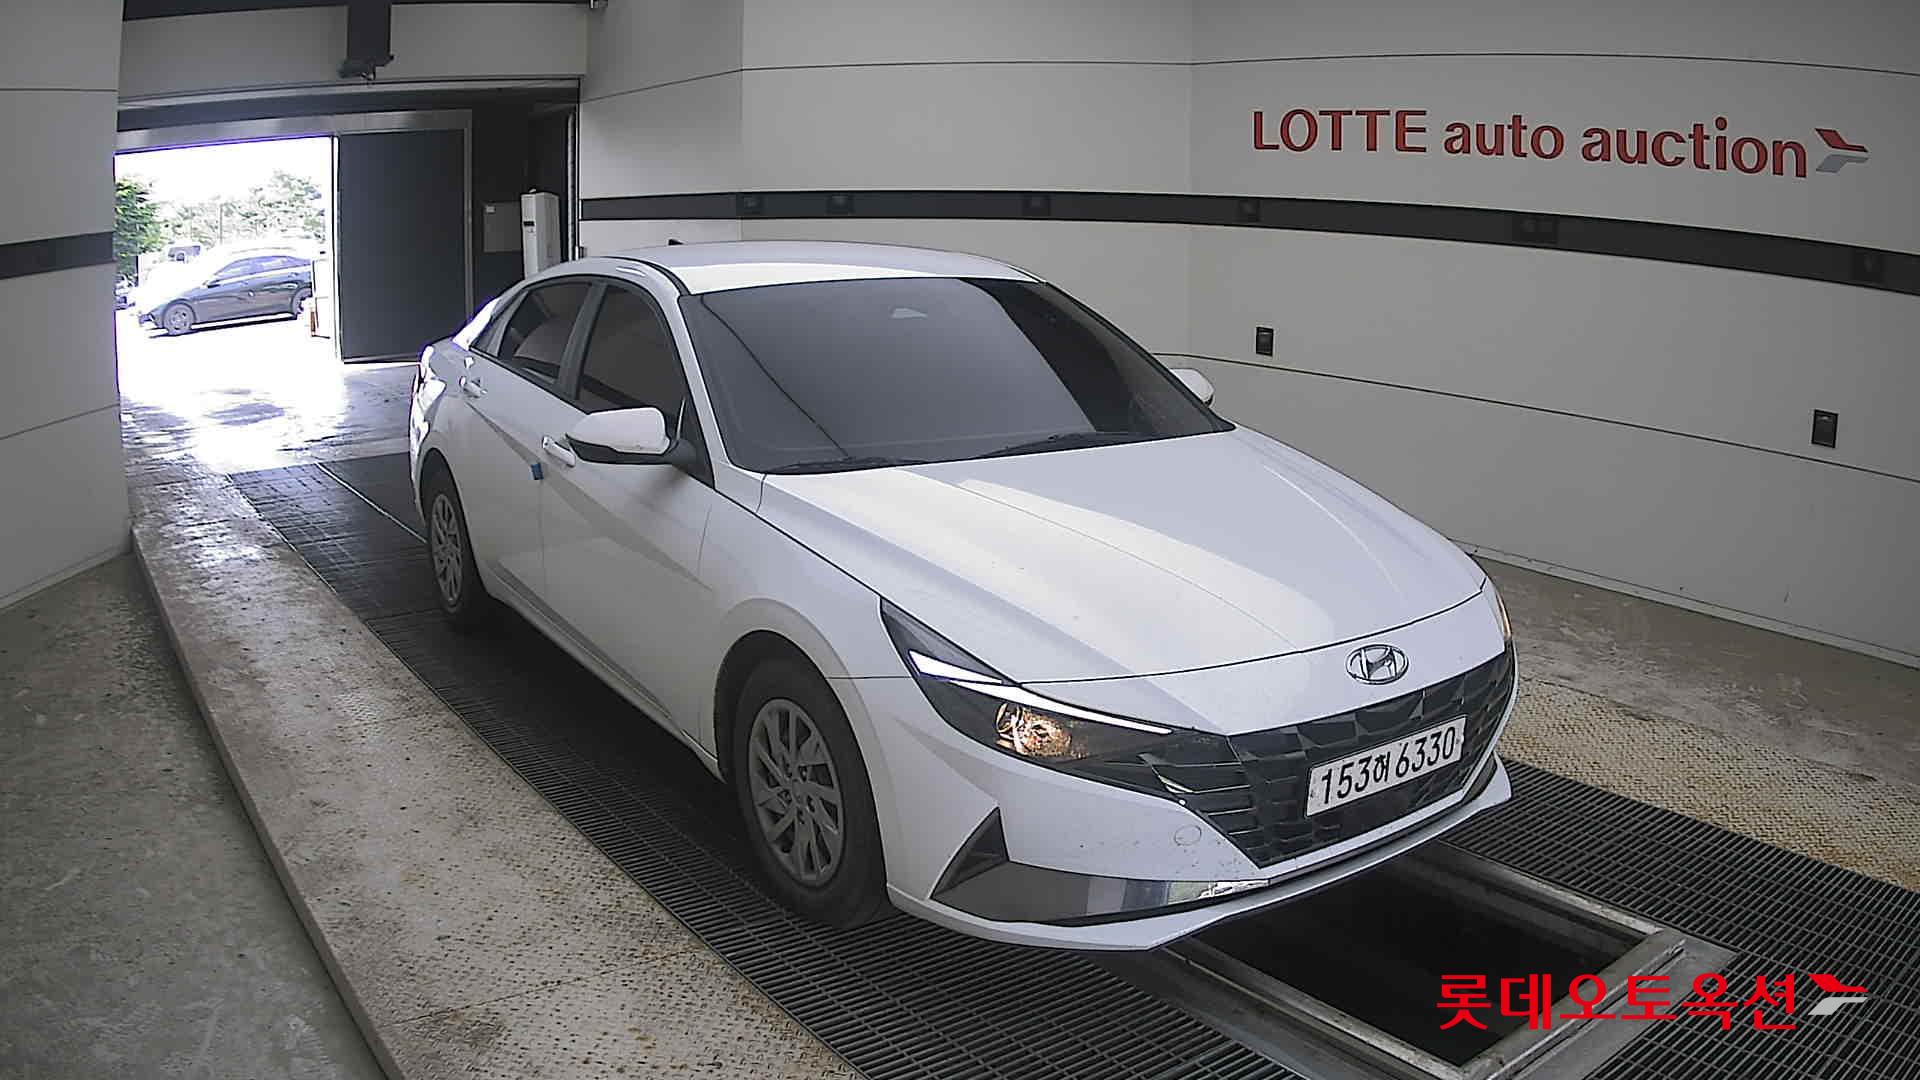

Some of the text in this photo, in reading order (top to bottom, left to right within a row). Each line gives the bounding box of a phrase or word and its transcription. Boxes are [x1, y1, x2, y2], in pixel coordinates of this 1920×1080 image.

[1253, 109, 1808, 178] LOTTE auto auction
